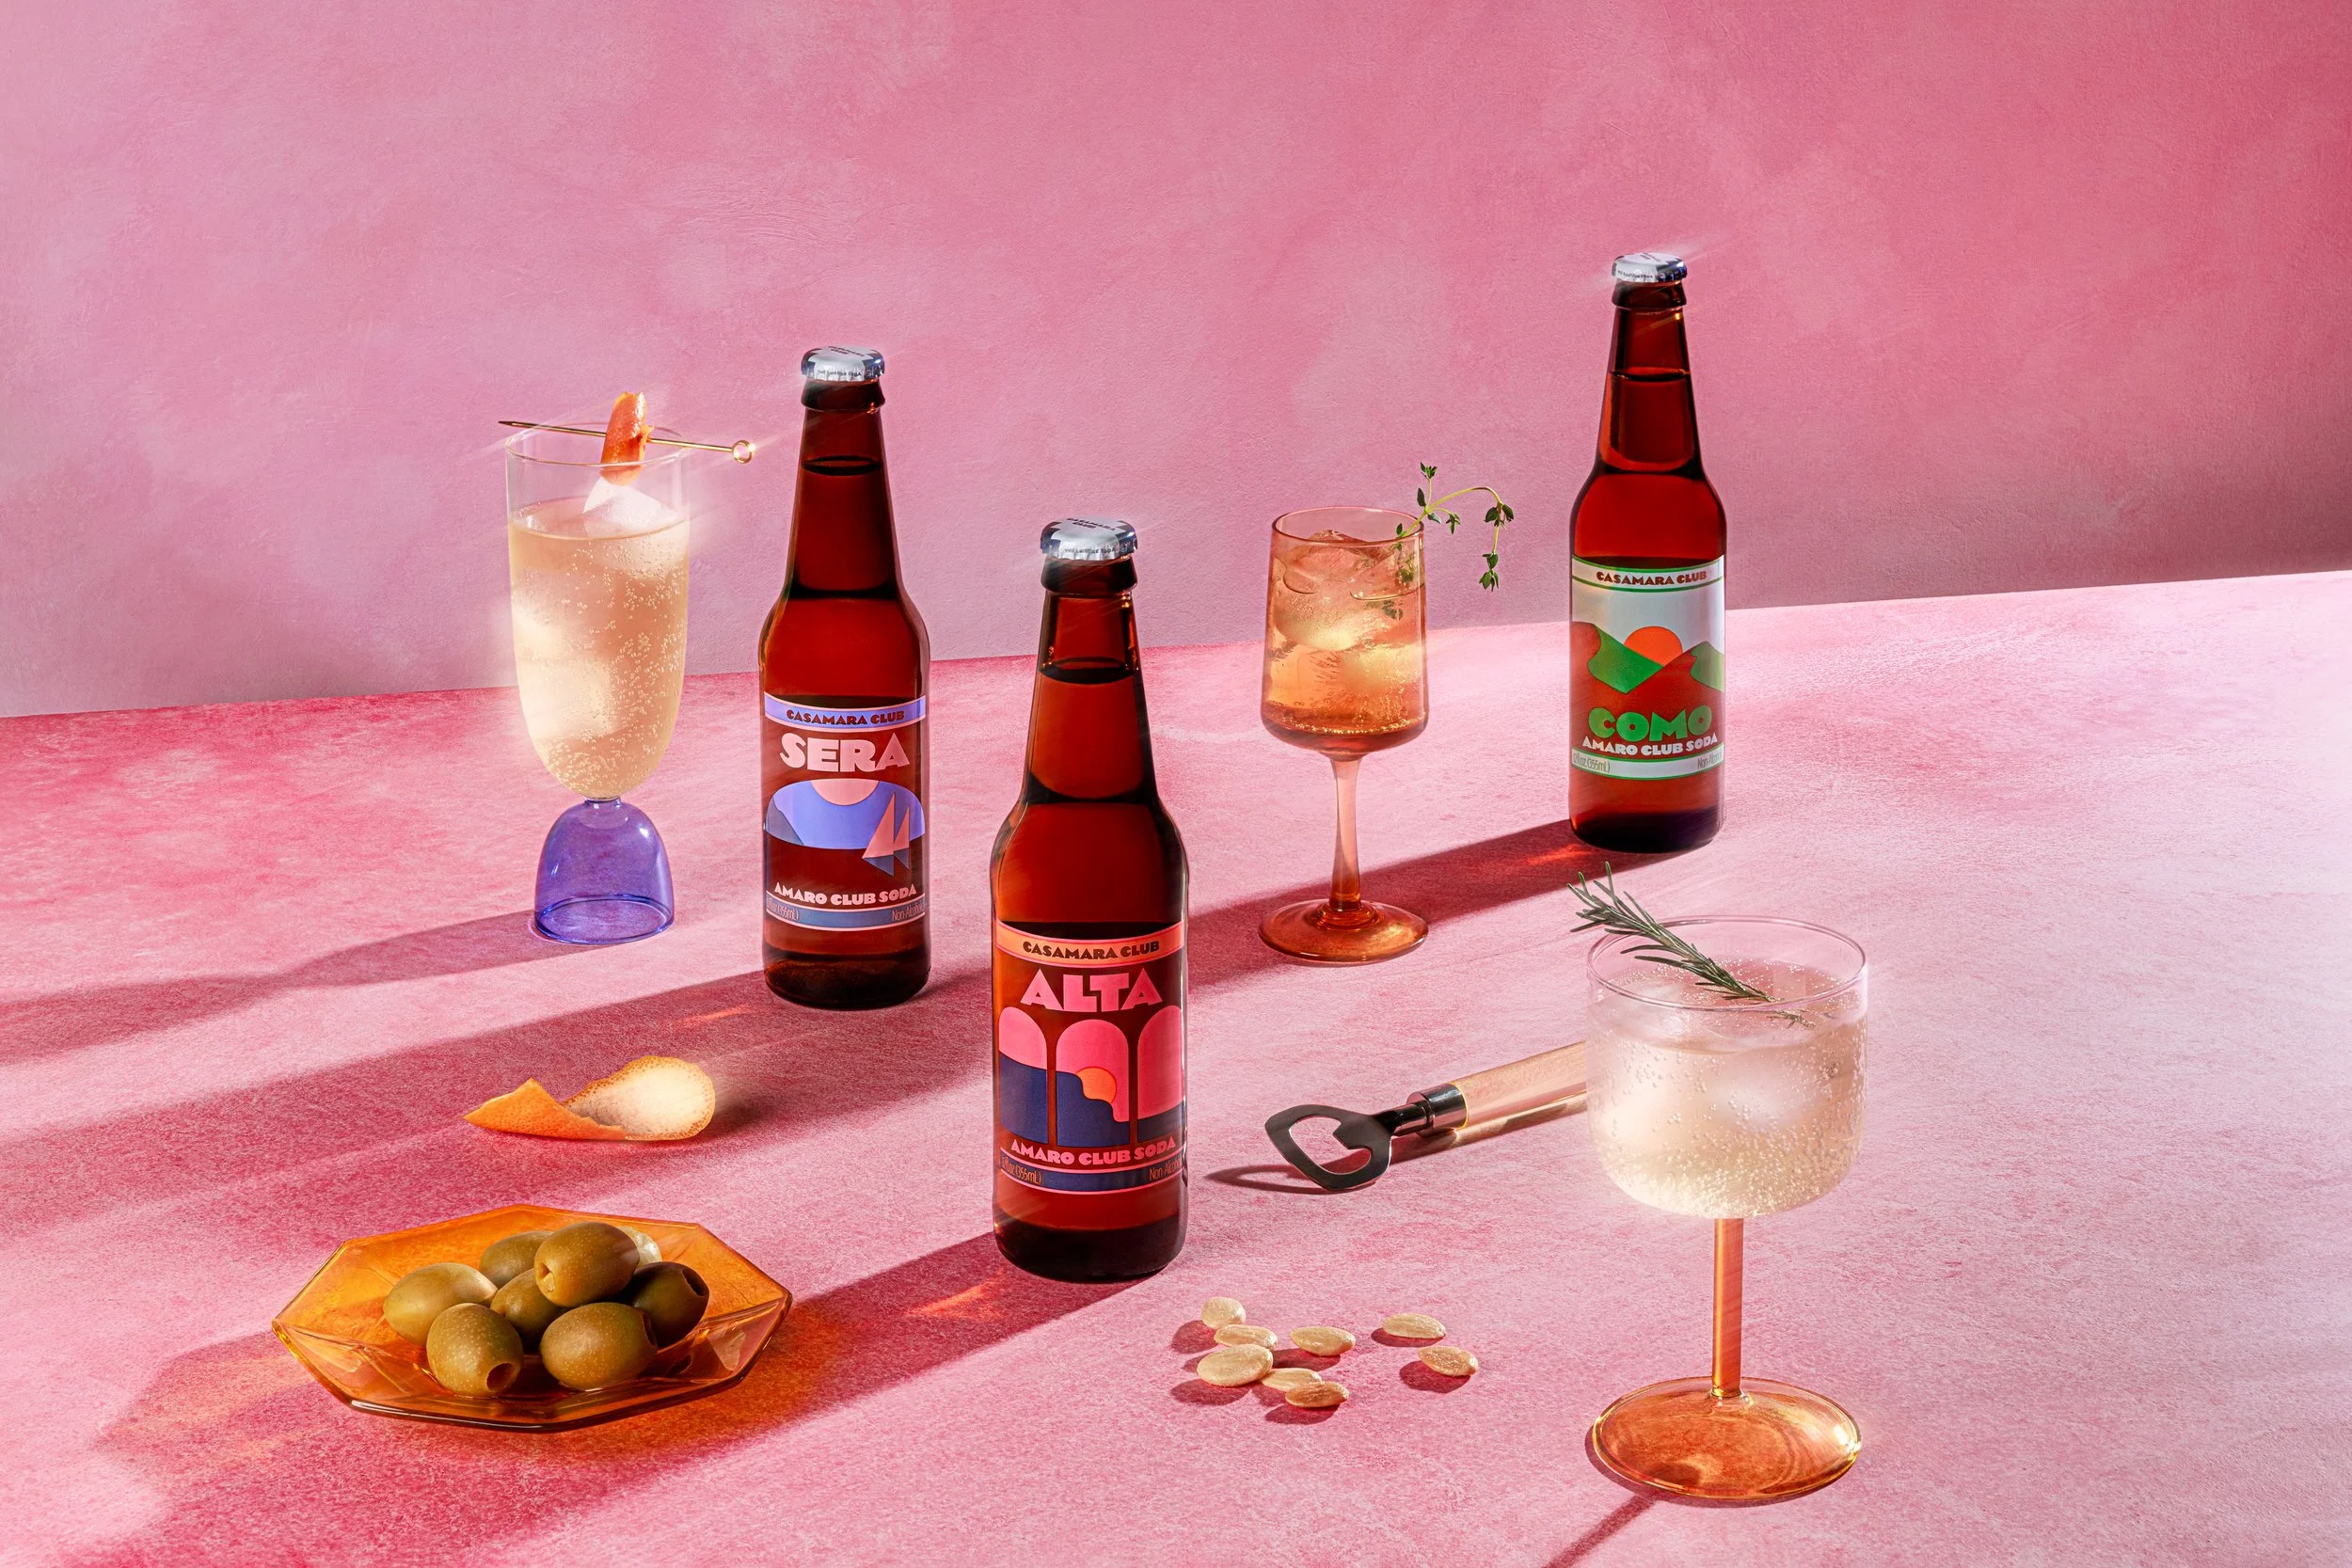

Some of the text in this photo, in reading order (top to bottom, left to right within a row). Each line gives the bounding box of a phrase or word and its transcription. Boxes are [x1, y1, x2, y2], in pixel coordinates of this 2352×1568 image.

[1596, 571, 1708, 585] CASAMARA CLUB
[787, 709, 904, 725] CASAMARA CLUB
[1588, 705, 1712, 742] COMO
[780, 732, 910, 772] SERA
[1582, 732, 1718, 755] AMARO CLUB SODA
[774, 881, 916, 906] AMARO CLUB SODA
[1023, 941, 1159, 959] CASAMARA CLUB
[1020, 967, 1163, 1012] ALTA
[1010, 1139, 1075, 1164] AMARO
[1078, 1149, 1131, 1165] CLUB
[1134, 1135, 1176, 1160] SODA
